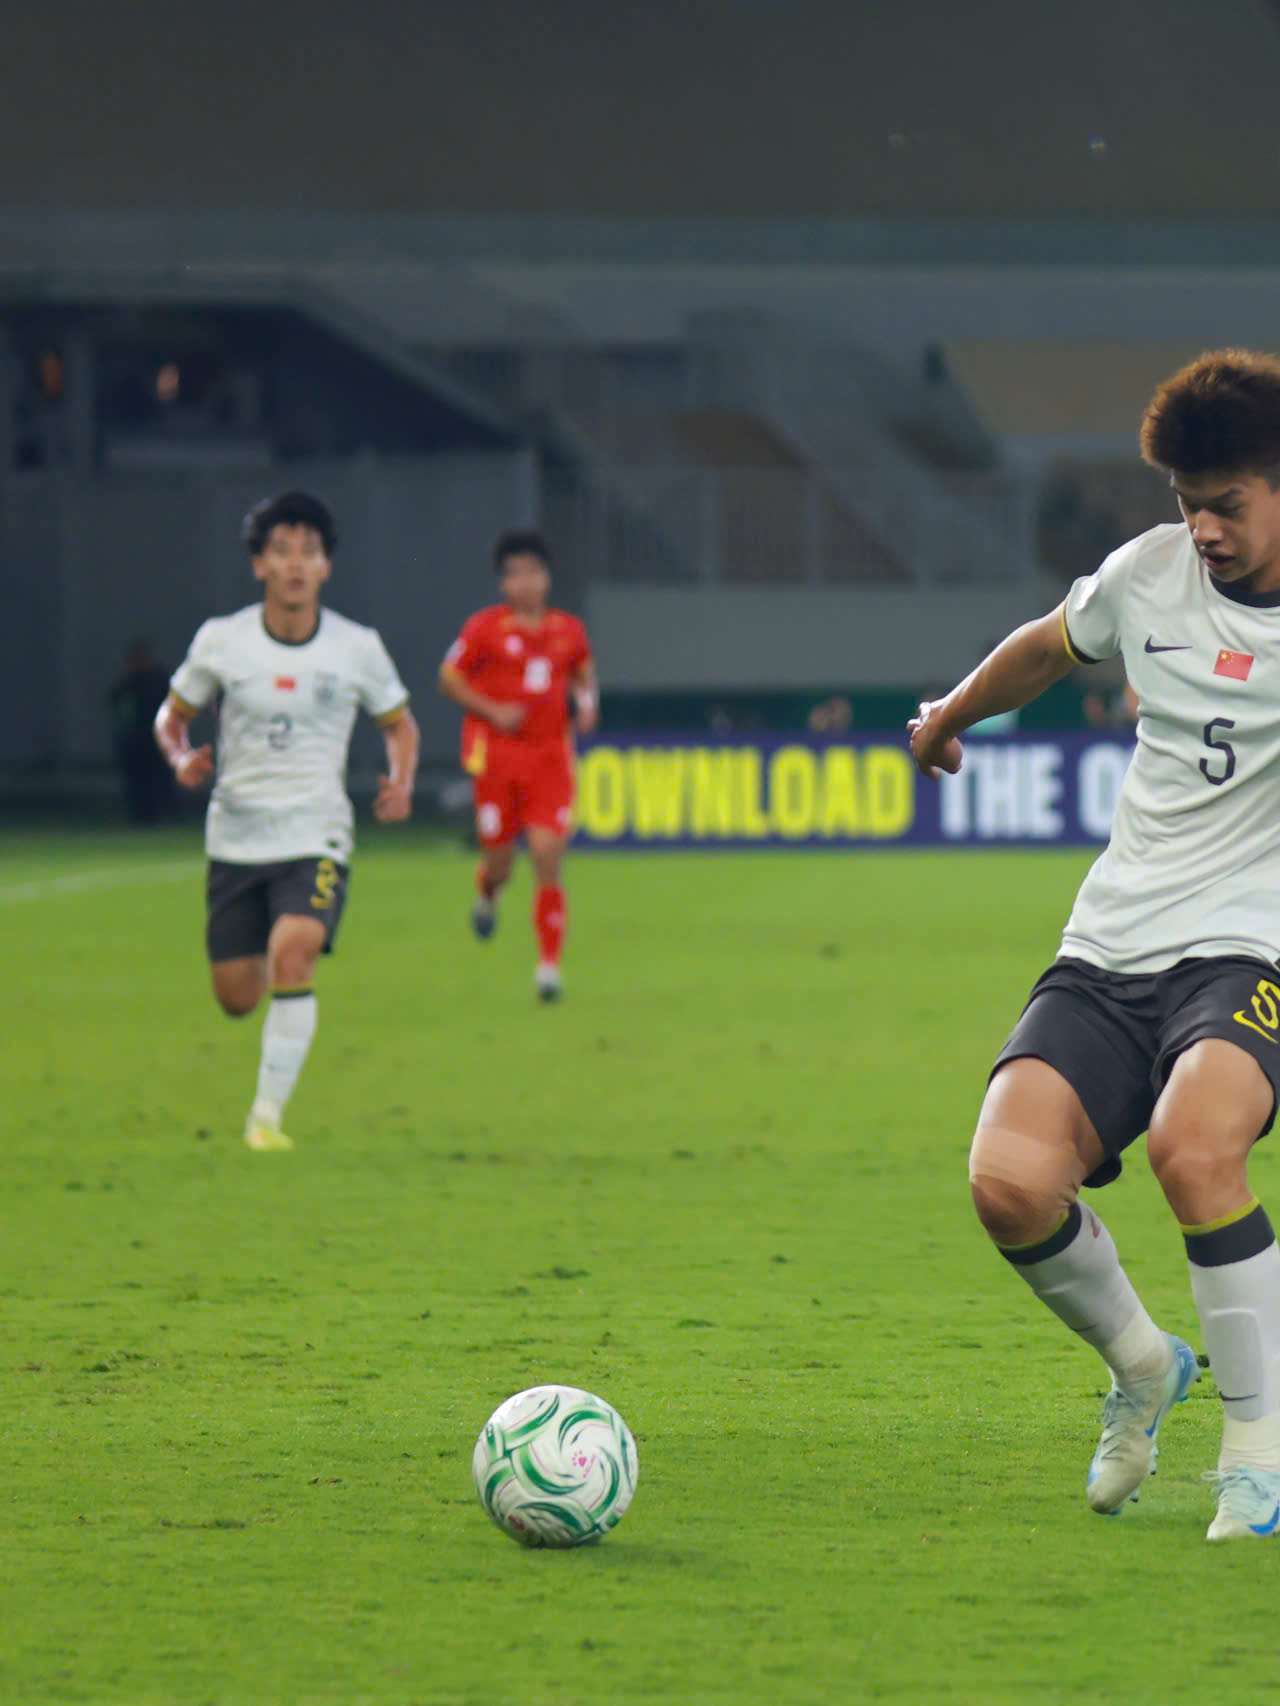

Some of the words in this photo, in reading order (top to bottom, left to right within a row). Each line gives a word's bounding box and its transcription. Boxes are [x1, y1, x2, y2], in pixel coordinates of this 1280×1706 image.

[576, 743, 915, 839] OWNLOAD
[941, 743, 1064, 838] THE
[1199, 717, 1236, 786] 5
